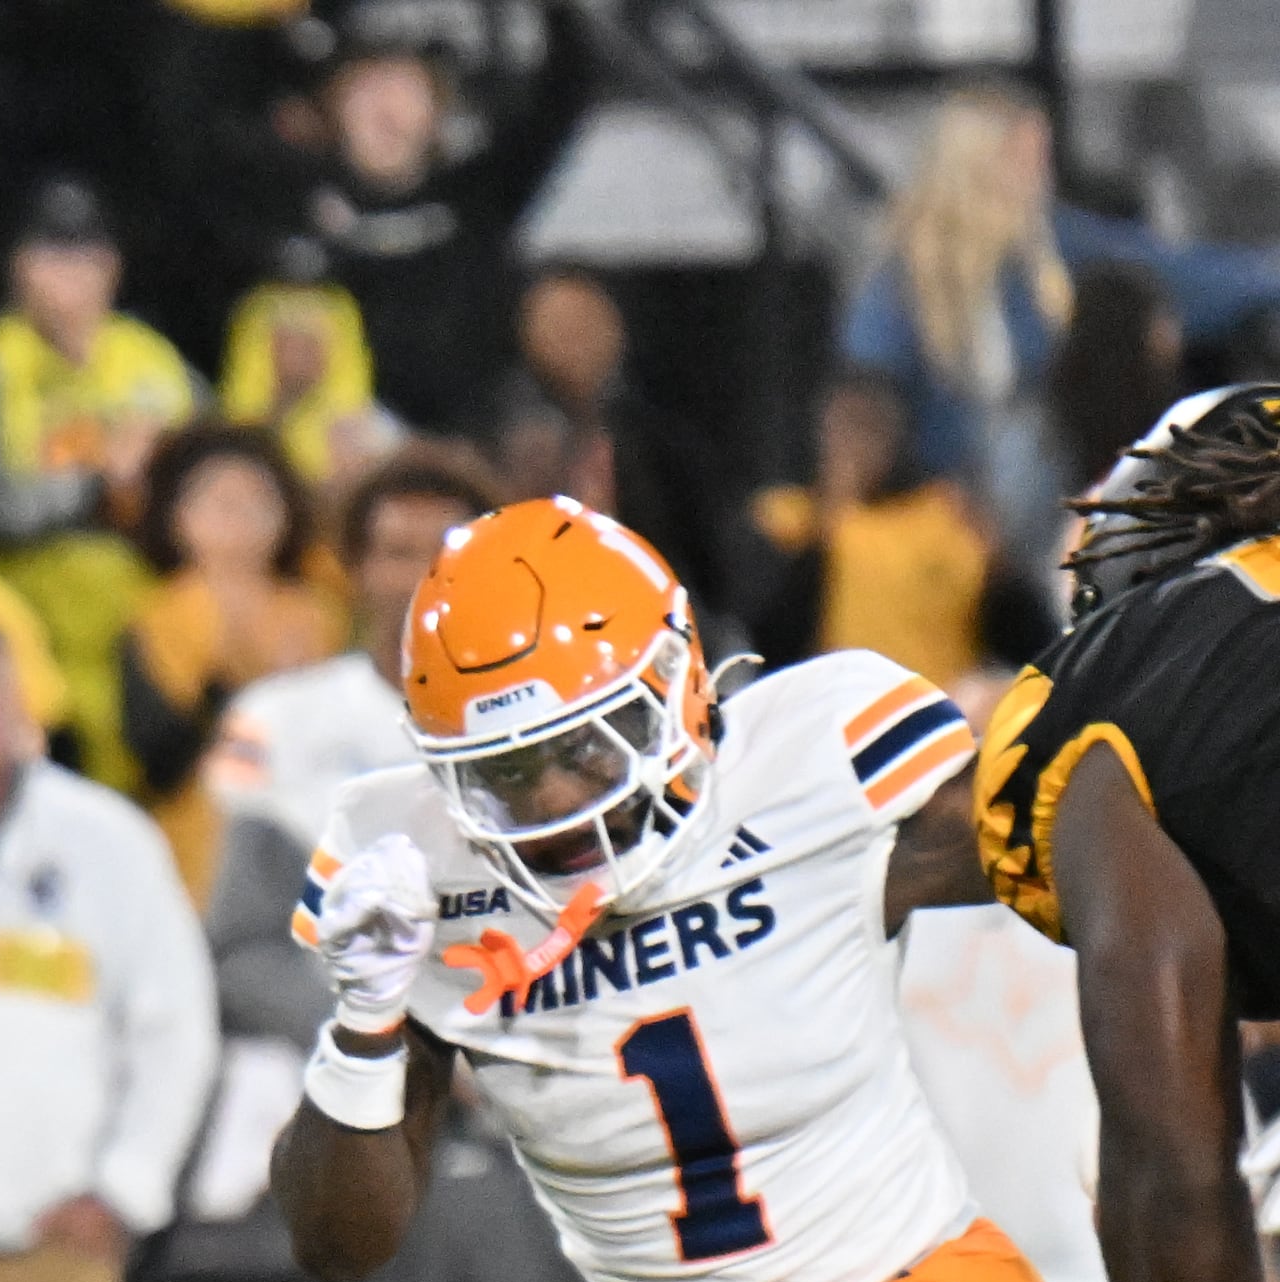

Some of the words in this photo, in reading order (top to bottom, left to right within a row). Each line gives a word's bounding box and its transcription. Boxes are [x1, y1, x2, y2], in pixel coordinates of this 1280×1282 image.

[475, 685, 536, 714] UNITY
[441, 886, 512, 920] USA
[613, 1003, 778, 1264] 1
